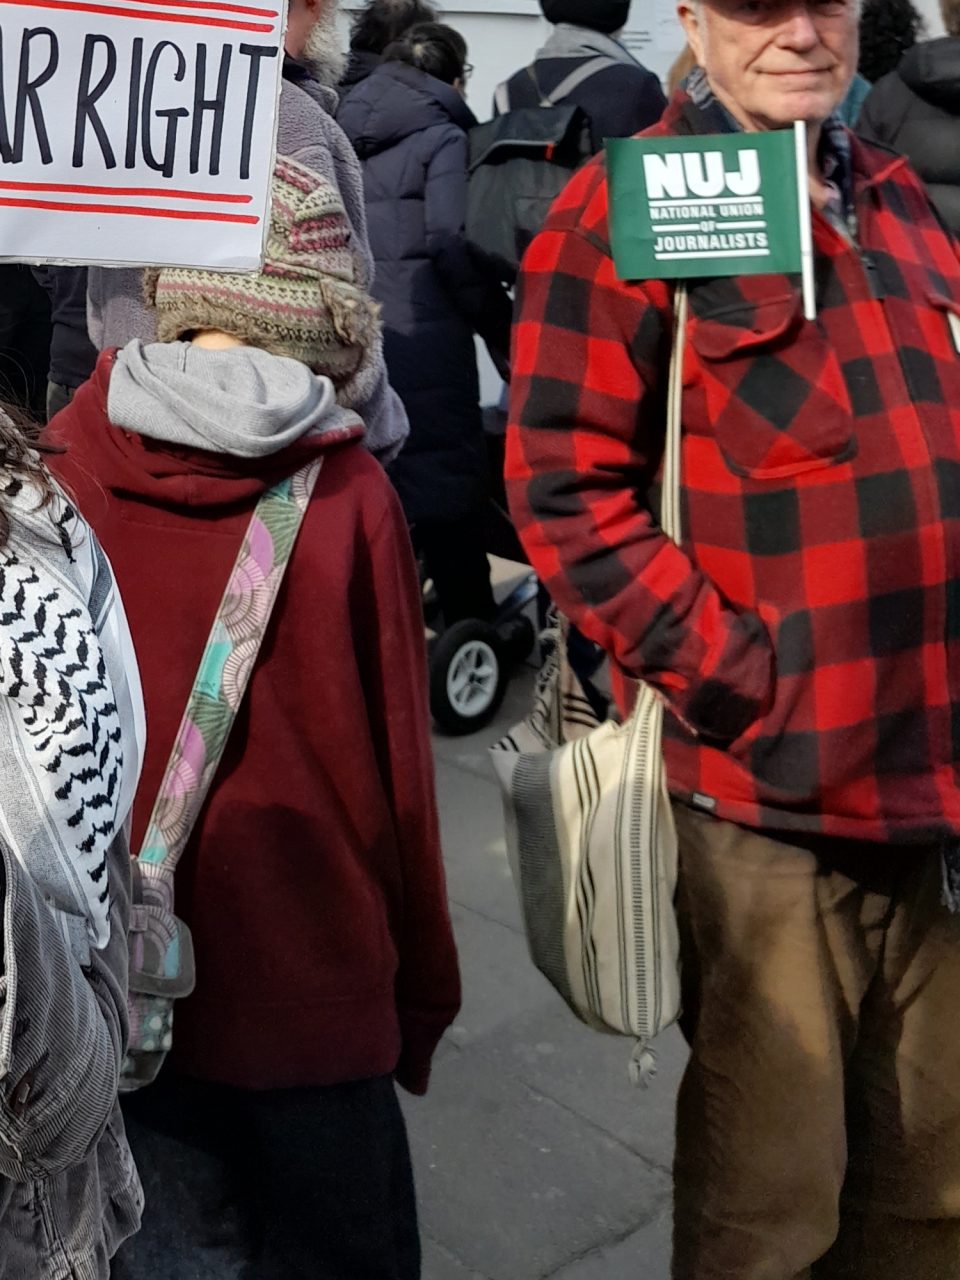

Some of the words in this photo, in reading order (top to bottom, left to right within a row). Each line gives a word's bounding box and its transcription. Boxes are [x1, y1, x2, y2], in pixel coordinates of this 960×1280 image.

[71, 33, 278, 181] RIGHT
[642, 149, 761, 199] NUJ
[649, 205, 717, 220] NATIONAL
[719, 203, 764, 217] UNION
[700, 220, 716, 232] OF
[654, 232, 768, 252] JOURNALISTS
